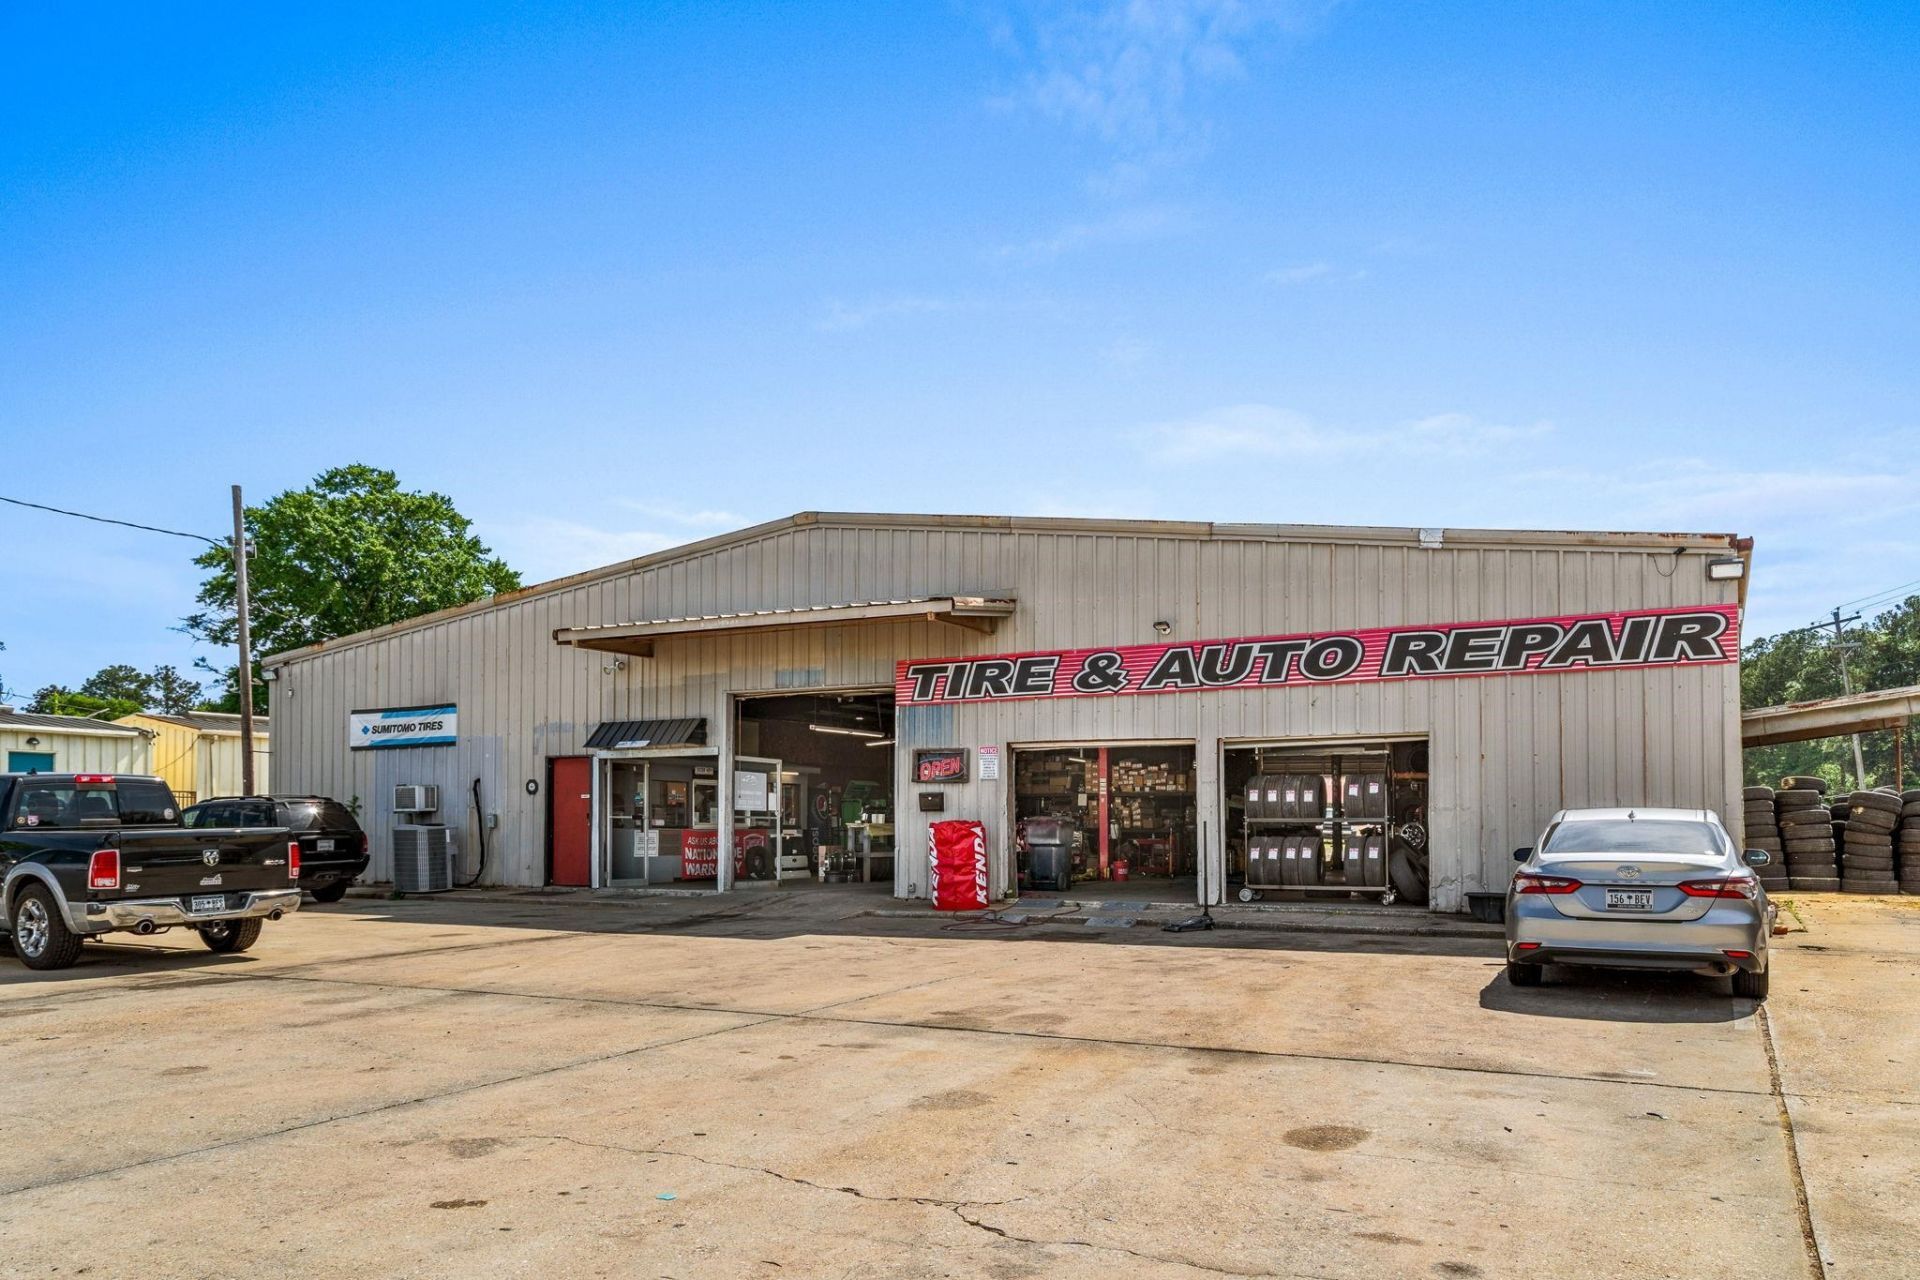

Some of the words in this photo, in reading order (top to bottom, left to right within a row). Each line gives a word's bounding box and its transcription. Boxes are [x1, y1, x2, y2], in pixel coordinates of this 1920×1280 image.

[907, 655, 1062, 701] TIRE
[1072, 652, 1130, 694] &
[1137, 635, 1365, 690] AUTO
[1378, 611, 1731, 678] REPAIR
[371, 723, 416, 735] SUMITOMO
[418, 720, 443, 731] TIRES
[920, 756, 960, 782] OPEN
[970, 826, 987, 905] KENDA
[1609, 894, 1624, 904] 156
[1634, 894, 1650, 905] BEV
